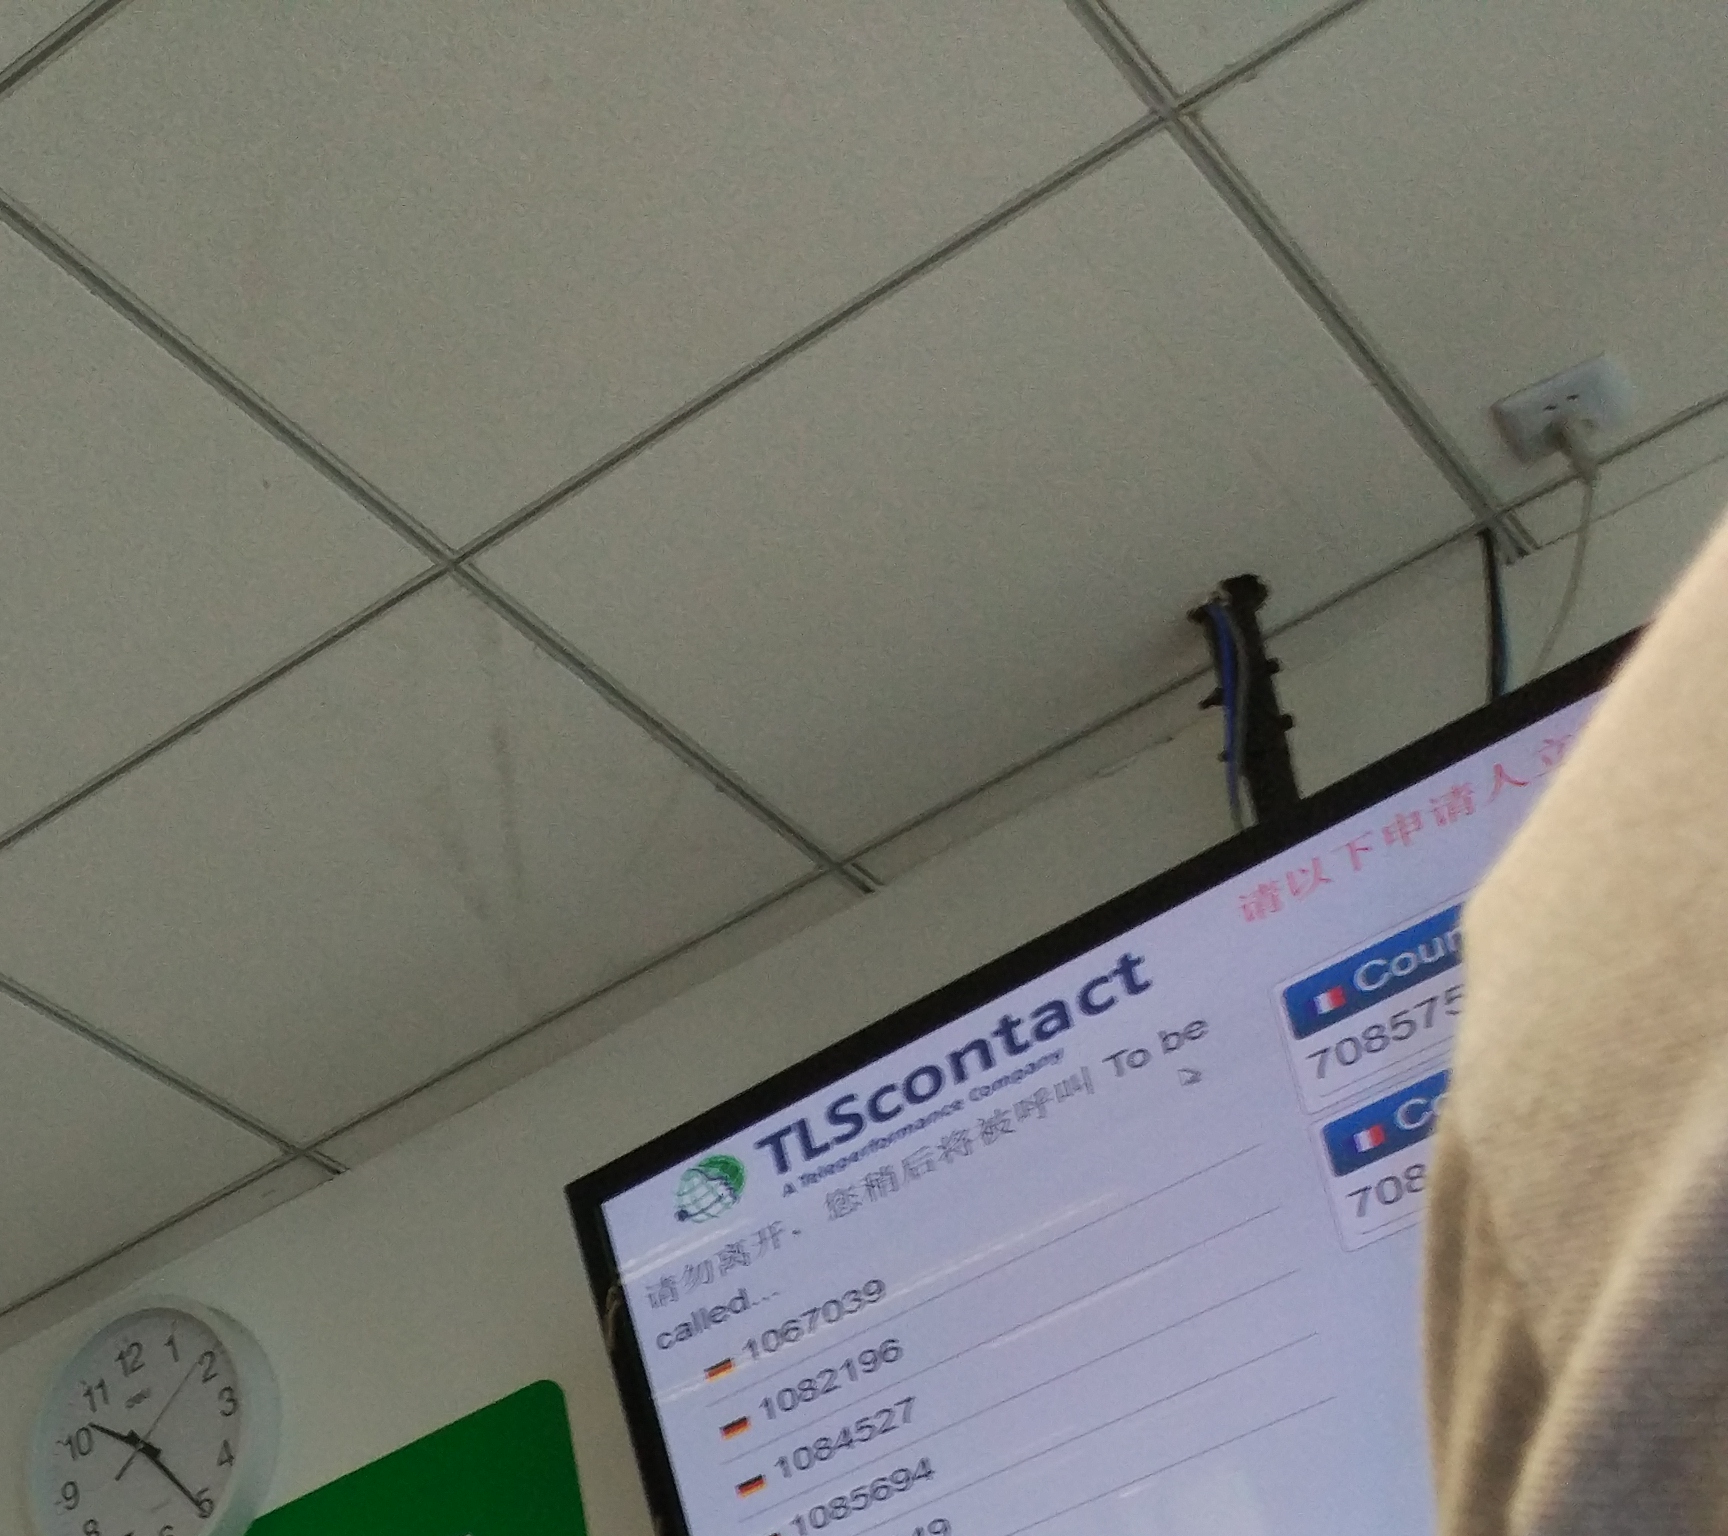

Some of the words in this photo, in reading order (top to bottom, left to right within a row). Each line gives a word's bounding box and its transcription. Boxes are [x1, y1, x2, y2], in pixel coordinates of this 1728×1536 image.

[754, 952, 1153, 1176] TLScontact
[1103, 1045, 1153, 1078] To
[1158, 1018, 1209, 1052] be
[968, 1047, 1065, 1102] Company
[742, 1279, 886, 1360] 1067039
[115, 1342, 145, 1377] 12
[164, 1334, 179, 1362] 1
[198, 1350, 218, 1383] 2
[758, 1338, 904, 1420] 1082196
[82, 1378, 110, 1413] 11
[217, 1386, 238, 1416] 3
[56, 1426, 93, 1461] 10
[217, 1439, 235, 1466] 4
[774, 1396, 917, 1478] 1084527
[60, 1481, 80, 1510] 9
[790, 1457, 936, 1536] 1085694
